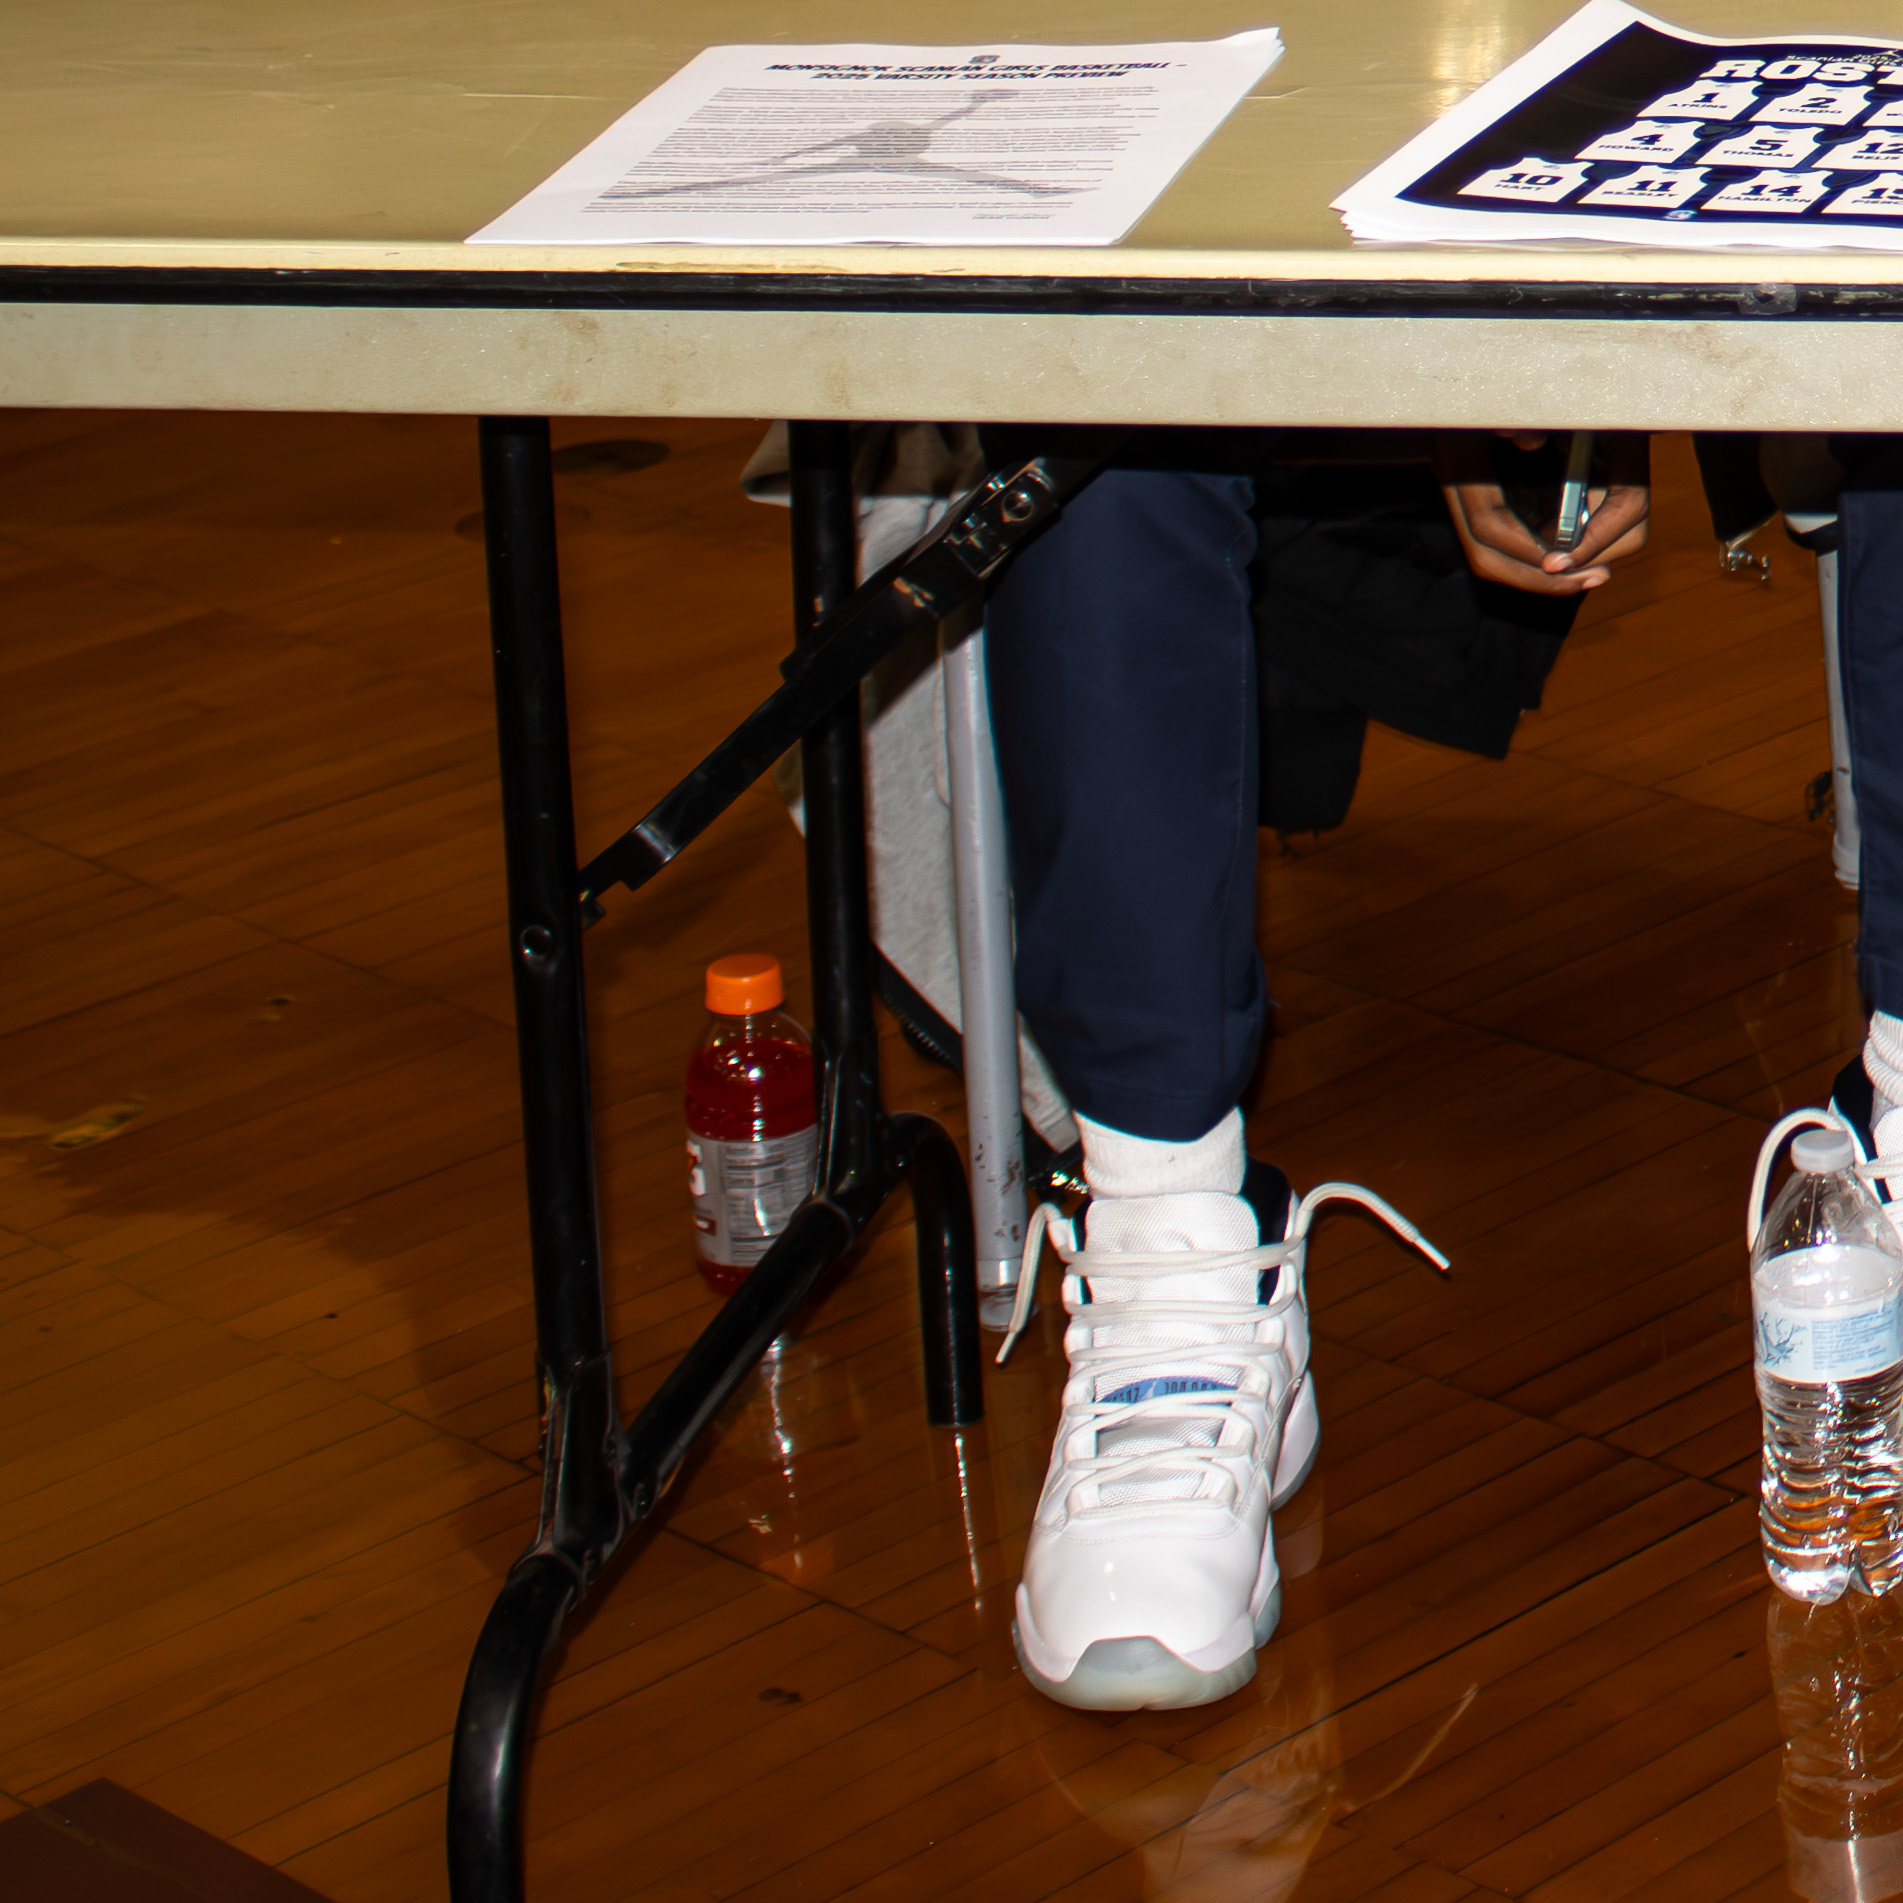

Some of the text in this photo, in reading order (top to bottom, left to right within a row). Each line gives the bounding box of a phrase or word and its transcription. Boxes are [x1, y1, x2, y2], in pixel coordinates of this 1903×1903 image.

[1785, 54, 1856, 63] Scanlan
[764, 64, 892, 72] MONSIGNOR
[988, 64, 1046, 72] GIRLS
[1050, 62, 1171, 72] BASKETBALL
[810, 70, 1131, 81] 2025 VARSITY SEASON PREVIEW
[1693, 92, 1720, 103] 1
[1801, 96, 1838, 109] 2
[1631, 133, 1665, 146] 4
[1597, 144, 1674, 152] HOWARD
[1749, 139, 1790, 152] 5
[1722, 150, 1794, 158] THOMAS
[1500, 172, 1563, 186] 10
[1627, 179, 1679, 192] 11
[1740, 184, 1802, 197] 14
[1601, 190, 1679, 198] BEASLEY
[1717, 195, 1813, 203] HAMILTON
